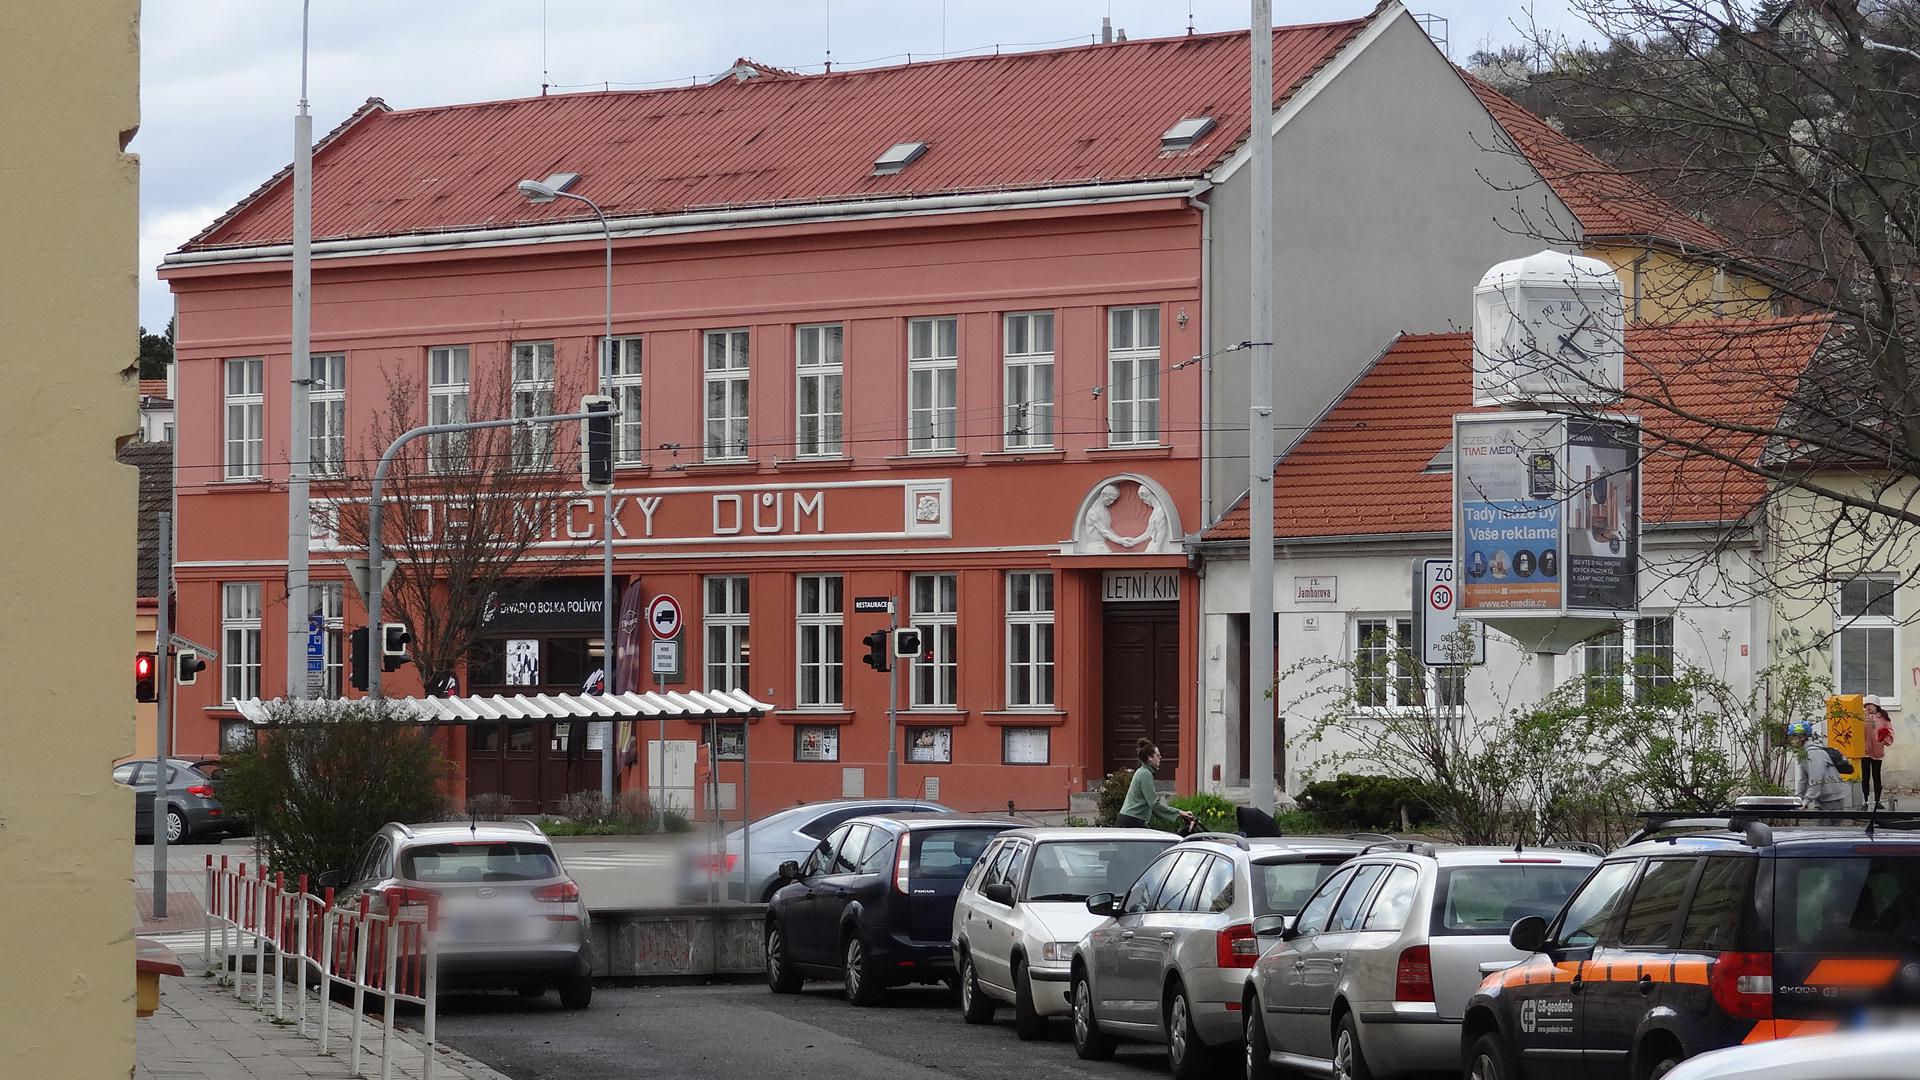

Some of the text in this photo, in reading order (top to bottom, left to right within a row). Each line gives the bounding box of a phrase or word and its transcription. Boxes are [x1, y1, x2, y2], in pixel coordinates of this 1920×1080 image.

[1462, 435, 1497, 446] CZECH
[1462, 446, 1488, 457] TIME
[712, 491, 825, 535] DŮM
[1463, 505, 1497, 524] Tady
[1468, 525, 1558, 541] Vaše reklama
[1107, 571, 1178, 599] LETNÍ KIN
[1297, 586, 1331, 598] Jamborova
[1434, 591, 1449, 604] 30
[567, 597, 603, 612] POLÍVKY
[1478, 599, 1547, 609] www.ct-media.cz
[1780, 985, 1818, 994] ŠKODA
